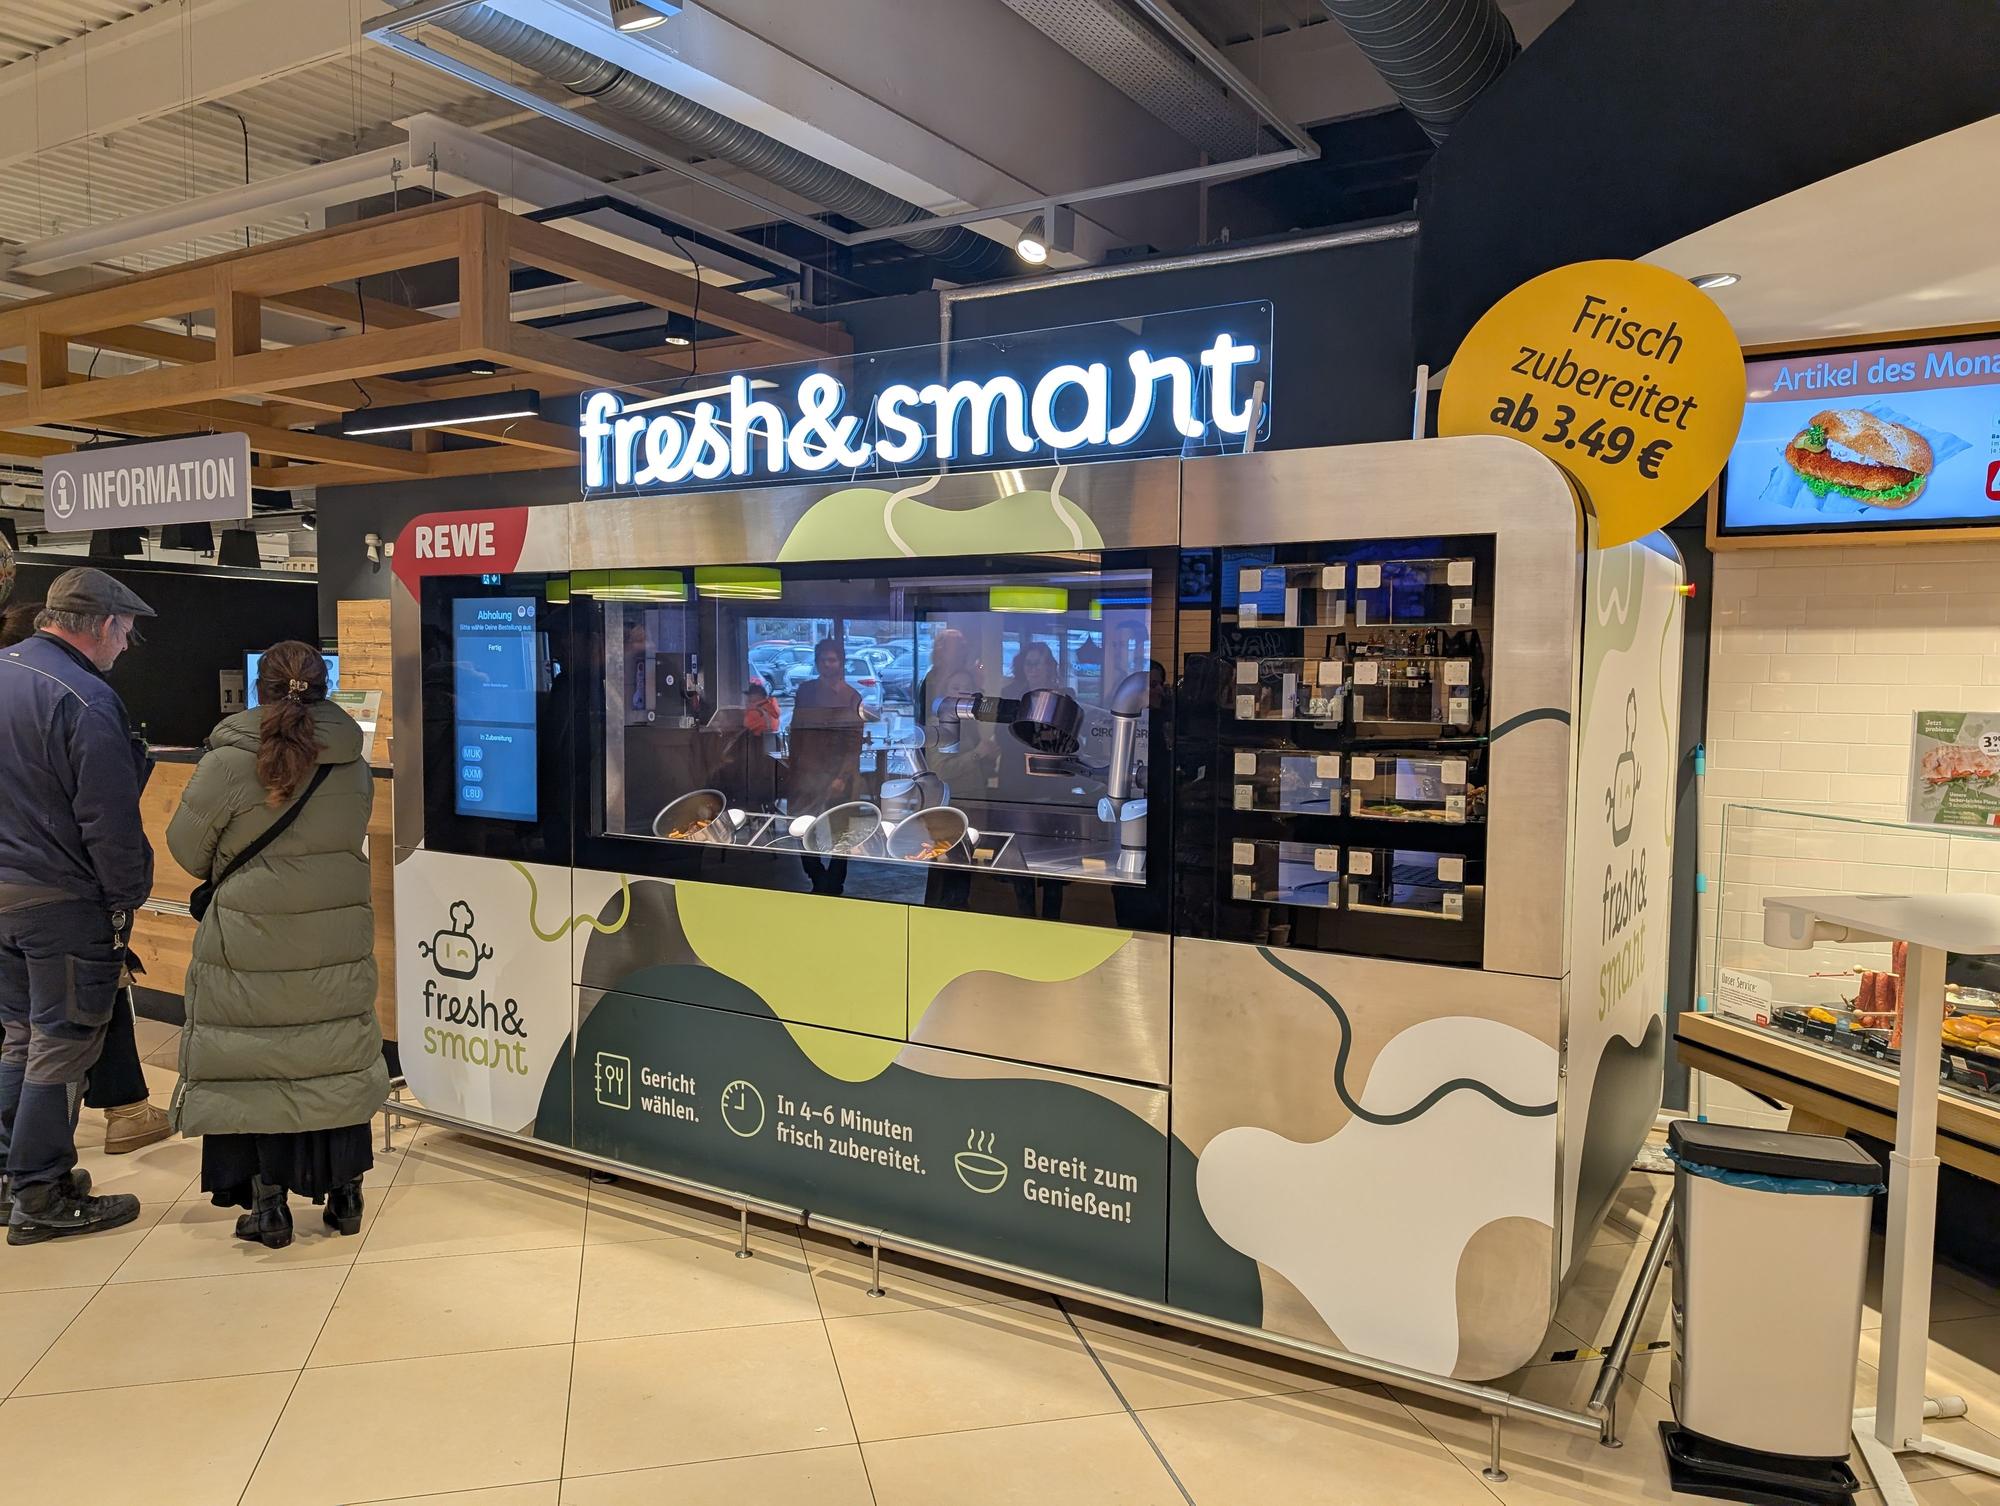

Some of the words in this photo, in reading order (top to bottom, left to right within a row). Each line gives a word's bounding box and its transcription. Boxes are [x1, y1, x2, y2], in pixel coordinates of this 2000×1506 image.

[1572, 294, 1683, 364] Frisch
[1511, 346, 1698, 430] zubereitet
[1773, 359, 1858, 391] Artikel
[1867, 356, 1917, 384] des
[1490, 392, 1539, 433] ab
[1542, 404, 1635, 465] 3.49
[1636, 439, 1673, 479] €
[82, 457, 236, 510] INFORMATION
[415, 522, 496, 559] REWE
[477, 610, 513, 622] Abholung
[488, 643, 502, 652] Fertig
[463, 748, 481, 759] MUK
[463, 768, 481, 780] AXM
[1602, 848, 1647, 946] fresh&
[1598, 919, 1646, 1021] smart
[1721, 972, 1735, 986] Unser
[423, 979, 528, 1038] fresh&
[423, 1026, 528, 1076] smart
[640, 1067, 696, 1096] Gericht
[640, 1095, 701, 1123] wählen.
[777, 1094, 795, 1116] In
[840, 1107, 913, 1143] Minuten
[776, 1121, 824, 1151] frisch
[828, 1137, 926, 1175] zubereitet.
[1023, 1147, 1087, 1182] Bereit
[1093, 1167, 1138, 1193] zum
[1023, 1178, 1131, 1224] Genießen!
